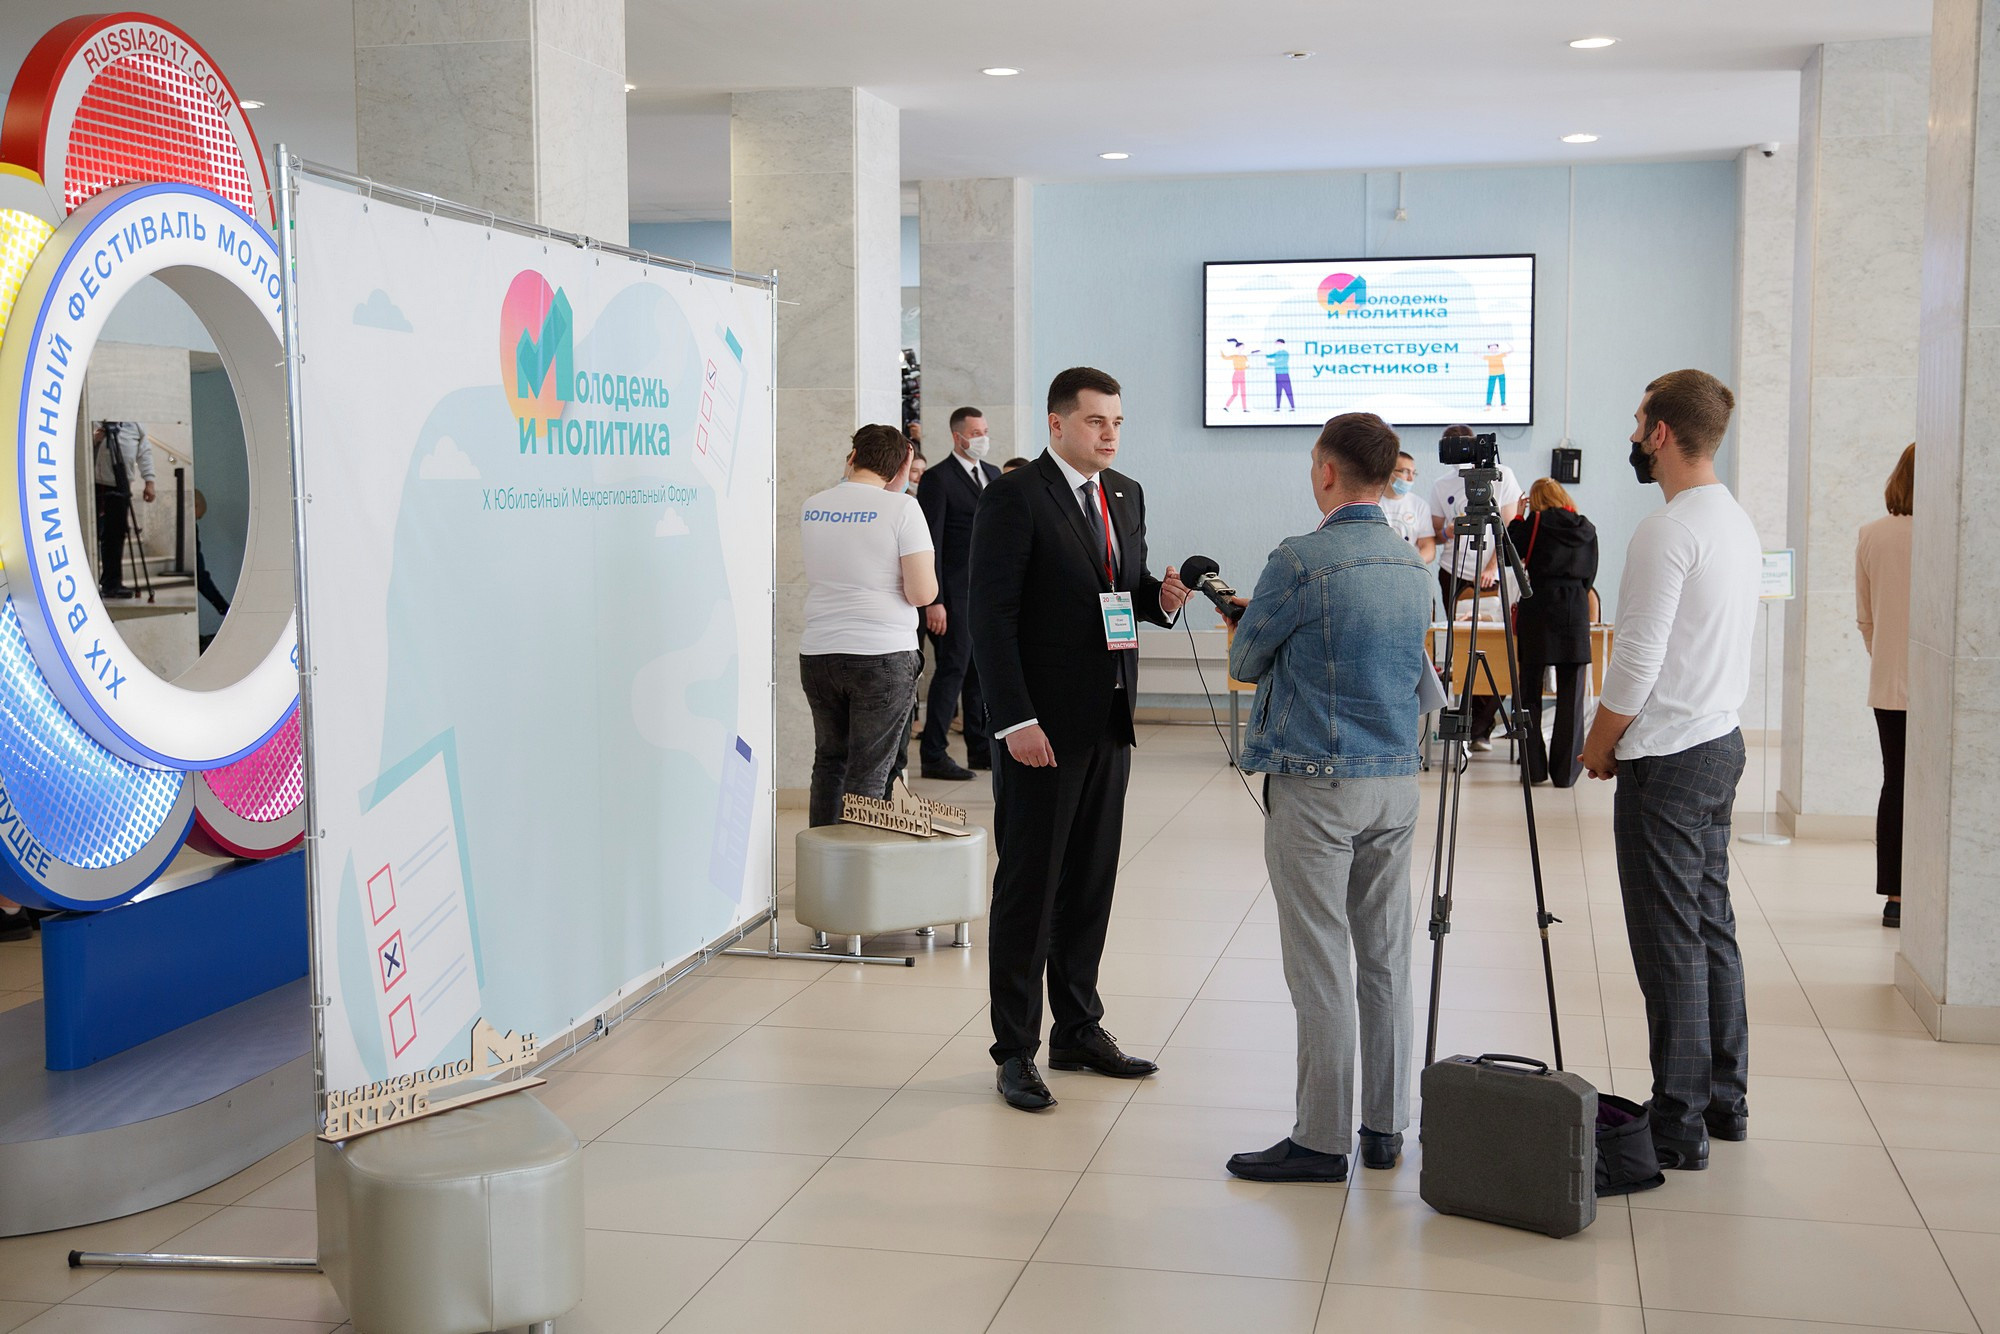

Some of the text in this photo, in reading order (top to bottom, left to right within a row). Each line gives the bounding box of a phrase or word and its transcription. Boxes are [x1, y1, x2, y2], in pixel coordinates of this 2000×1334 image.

[83, 28, 232, 117] RUSSIA2017.COM
[516, 286, 669, 412] Молодежь
[1304, 341, 1459, 357] Приветствуем
[1312, 362, 1438, 378] участников
[38, 333, 88, 633] ВСЕМИРНЫЙ
[68, 211, 207, 321] ФЕСТИВАЛЬ
[218, 224, 282, 312] МОЛО
[519, 417, 670, 456] и политика
[494, 486, 568, 510] Юбилейный
[572, 486, 665, 511] Межрегиональный
[667, 485, 698, 507] Форум
[804, 510, 878, 523] ВОЛОНТЕР
